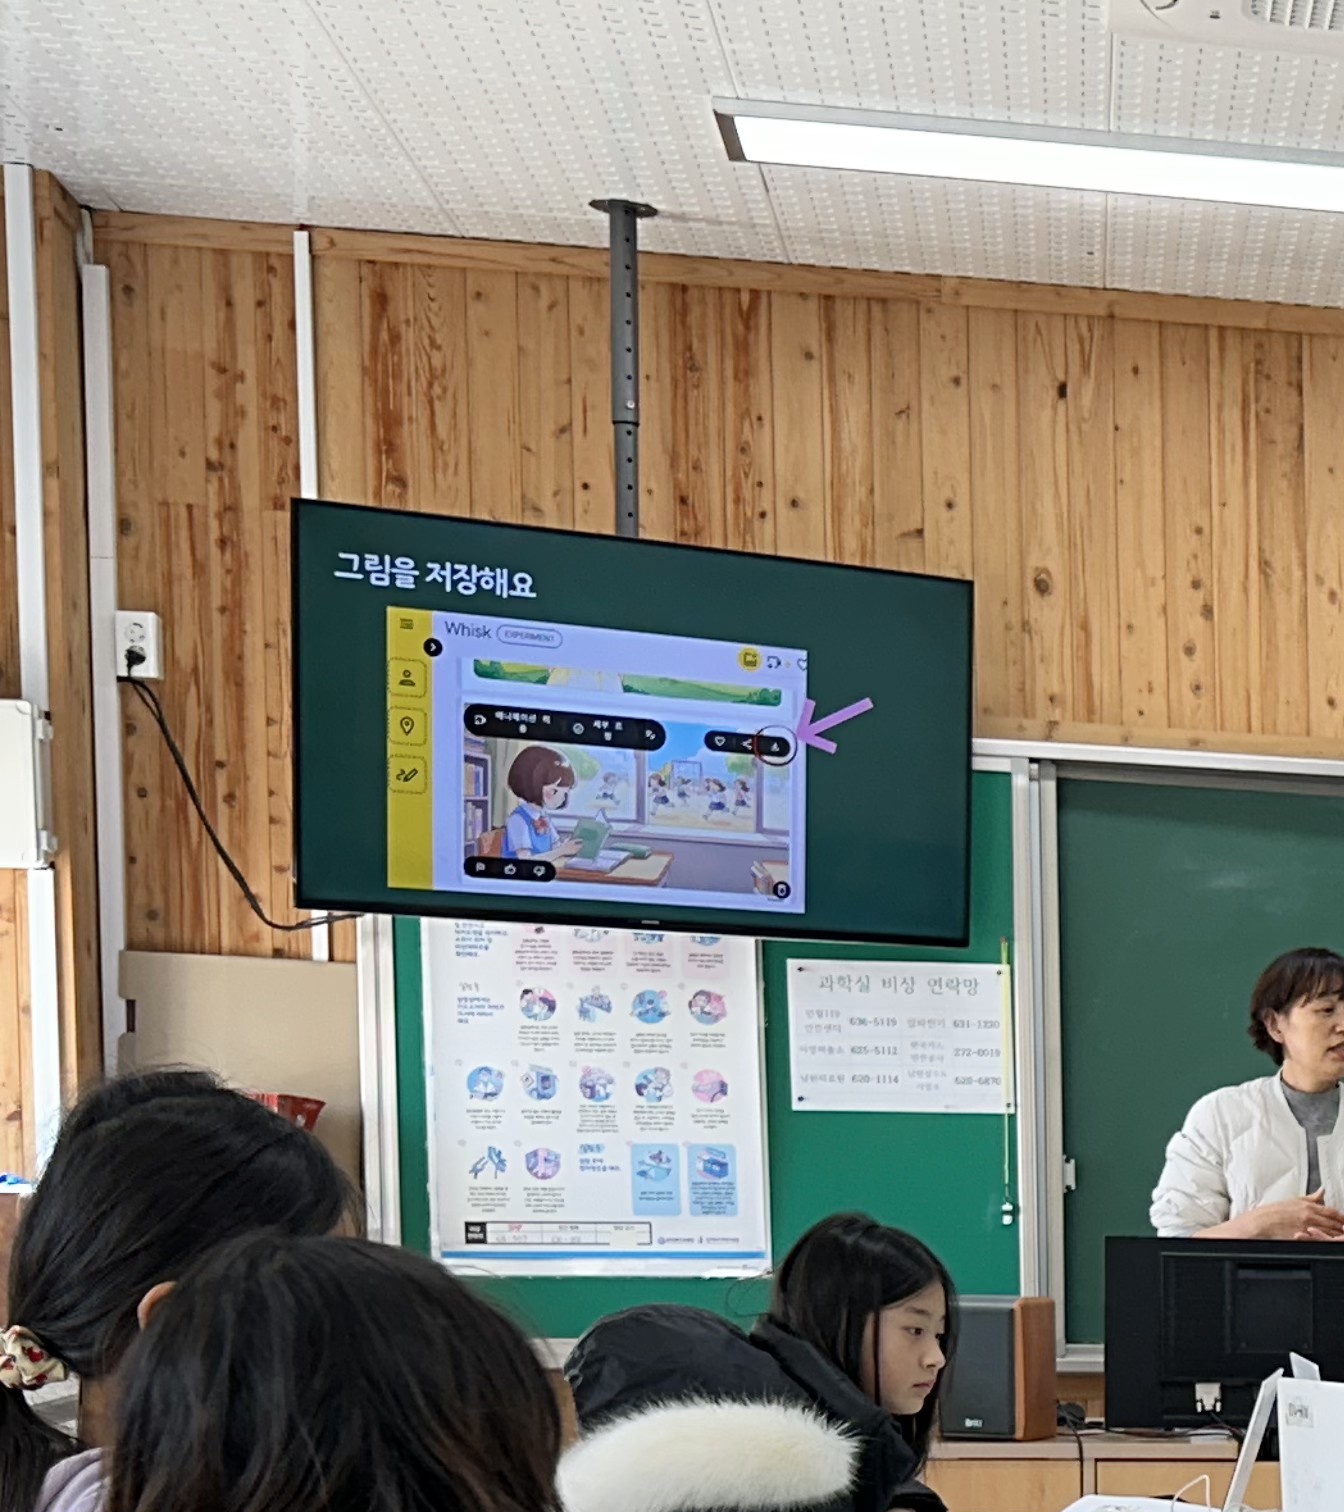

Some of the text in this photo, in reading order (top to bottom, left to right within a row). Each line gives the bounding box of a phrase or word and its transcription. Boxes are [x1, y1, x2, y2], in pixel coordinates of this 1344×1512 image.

[334, 552, 537, 599] 그림을 저장해요
[444, 620, 492, 640] Whisk
[819, 974, 979, 996] 과학실 비상 연락망
